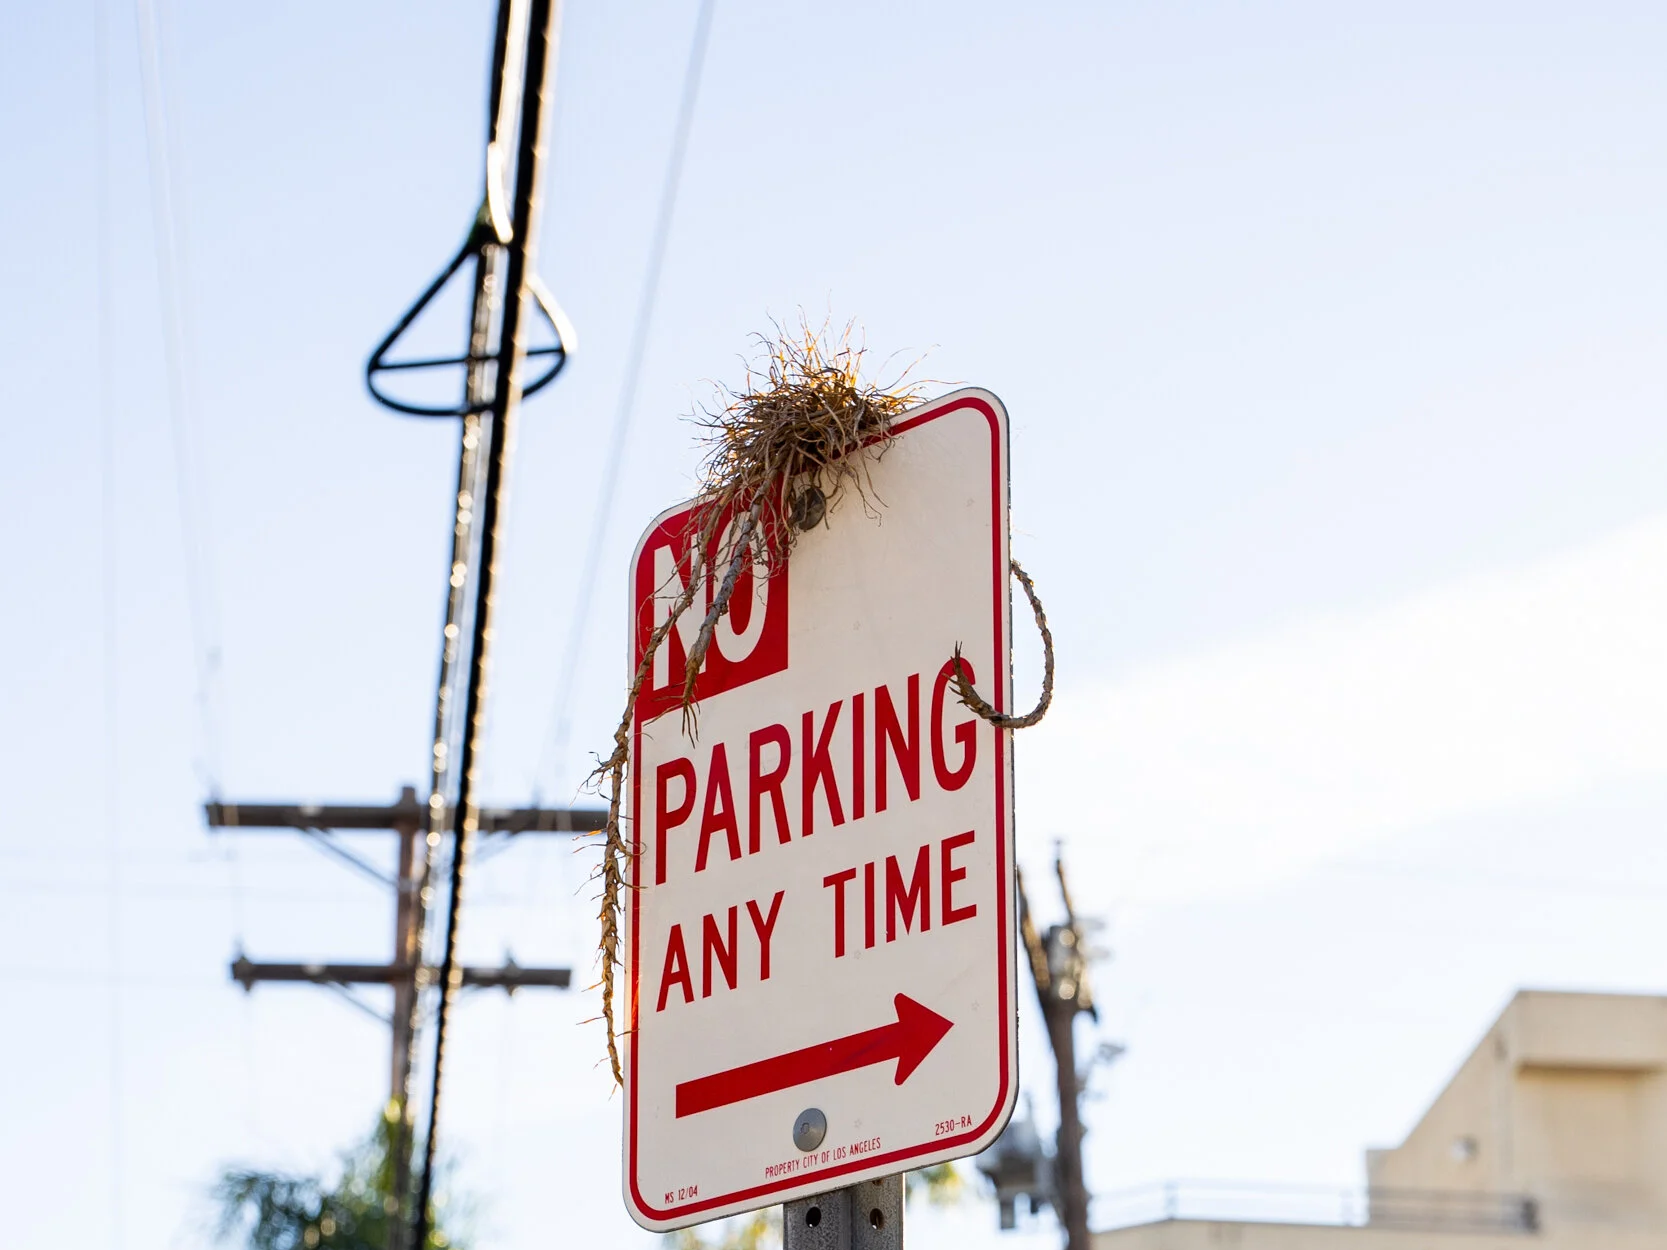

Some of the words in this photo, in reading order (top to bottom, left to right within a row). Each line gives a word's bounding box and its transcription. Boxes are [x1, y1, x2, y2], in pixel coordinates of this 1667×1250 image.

[653, 509, 769, 692] NO
[656, 657, 977, 886] PARKING
[656, 890, 785, 1013] ANY
[823, 830, 977, 958] TIME
[765, 1160, 800, 1178] PROPERTY
[803, 1154, 818, 1168] CITY
[821, 1150, 831, 1163] OF
[833, 1146, 847, 1161] LOS
[849, 1137, 881, 1156] ANGELES
[935, 1115, 972, 1136] 2530-RA
[678, 1185, 698, 1201] 12/04
